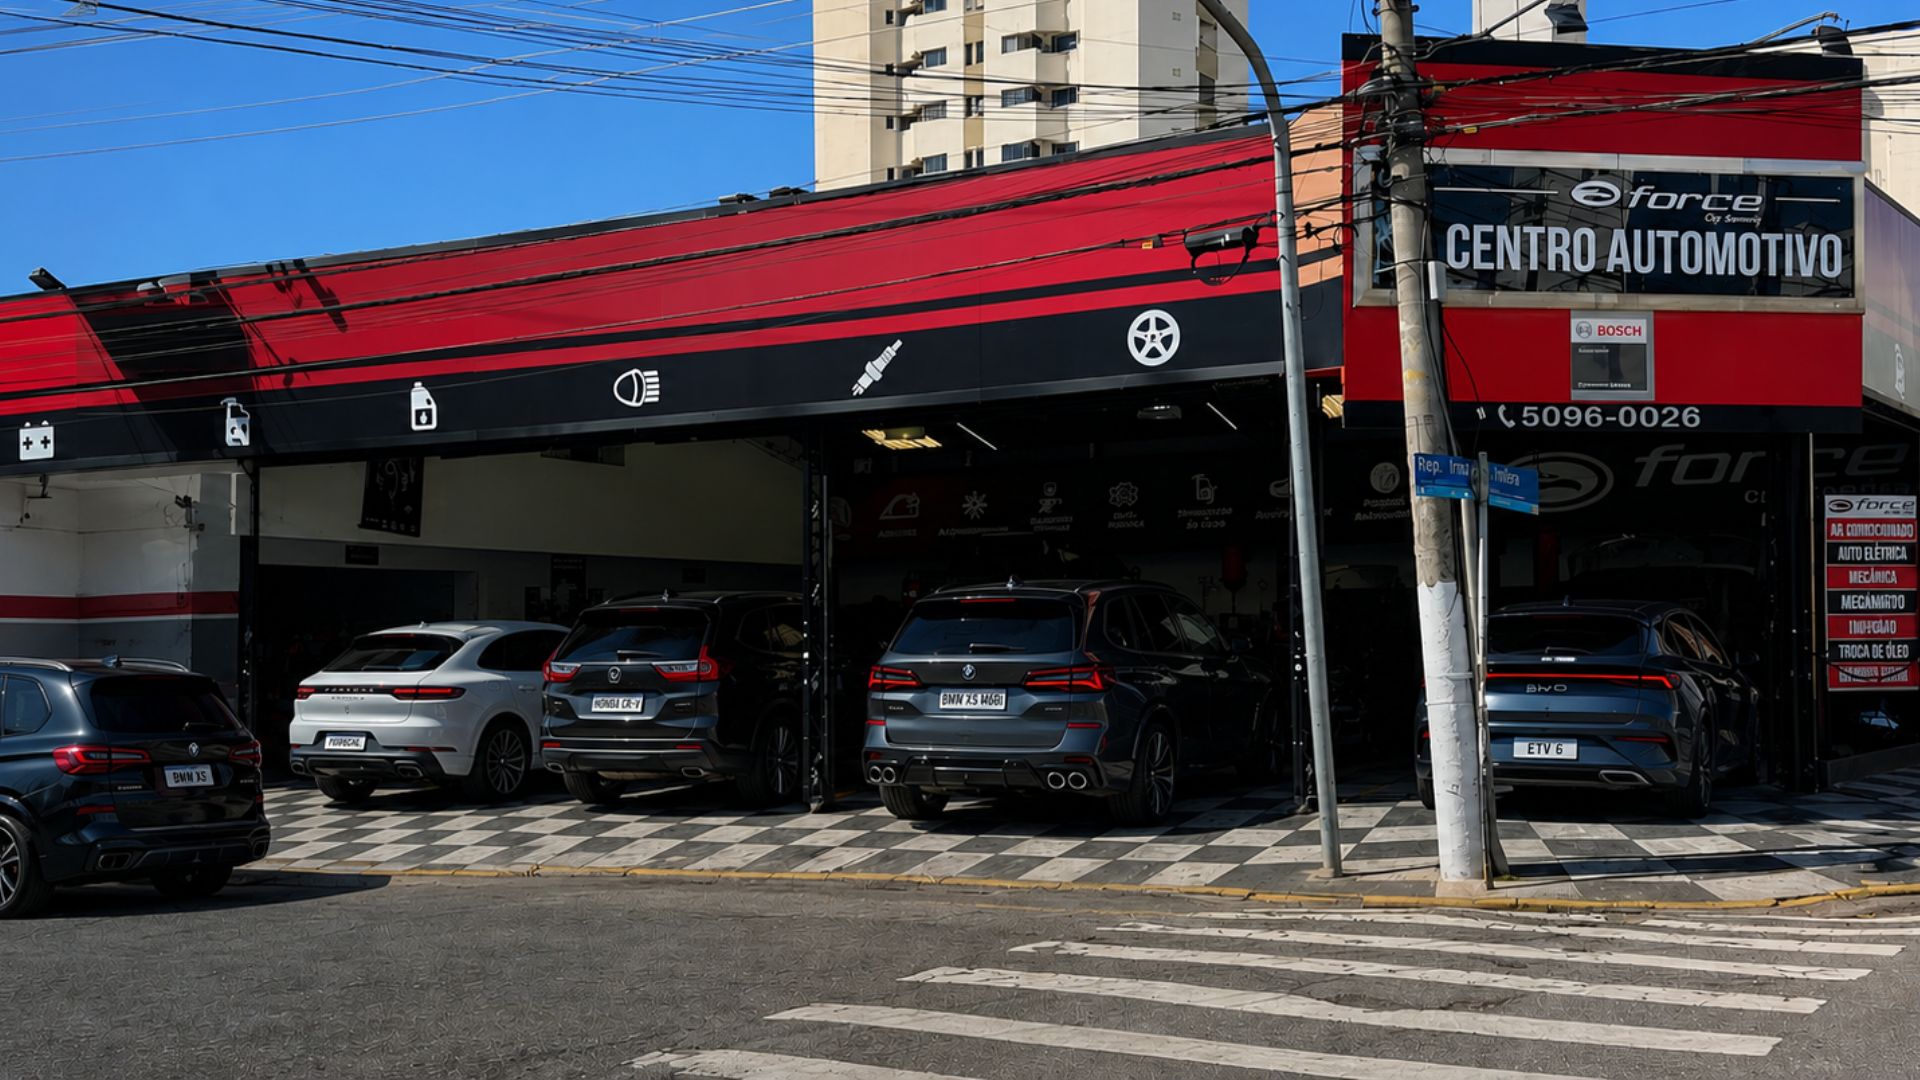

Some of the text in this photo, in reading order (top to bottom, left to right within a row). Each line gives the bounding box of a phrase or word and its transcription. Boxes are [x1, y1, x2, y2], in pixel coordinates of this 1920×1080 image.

[1628, 185, 1763, 212] force
[1446, 224, 1843, 278] CENTRO AUTOMOTIVO
[1597, 325, 1642, 337] BOSCH
[1521, 406, 1701, 428] 5096-0026
[1855, 498, 1915, 511] force
[1838, 546, 1863, 561] AUTO
[1838, 641, 1910, 659] TROCA DE ÓLEO
[1527, 743, 1563, 755] ETV 6
